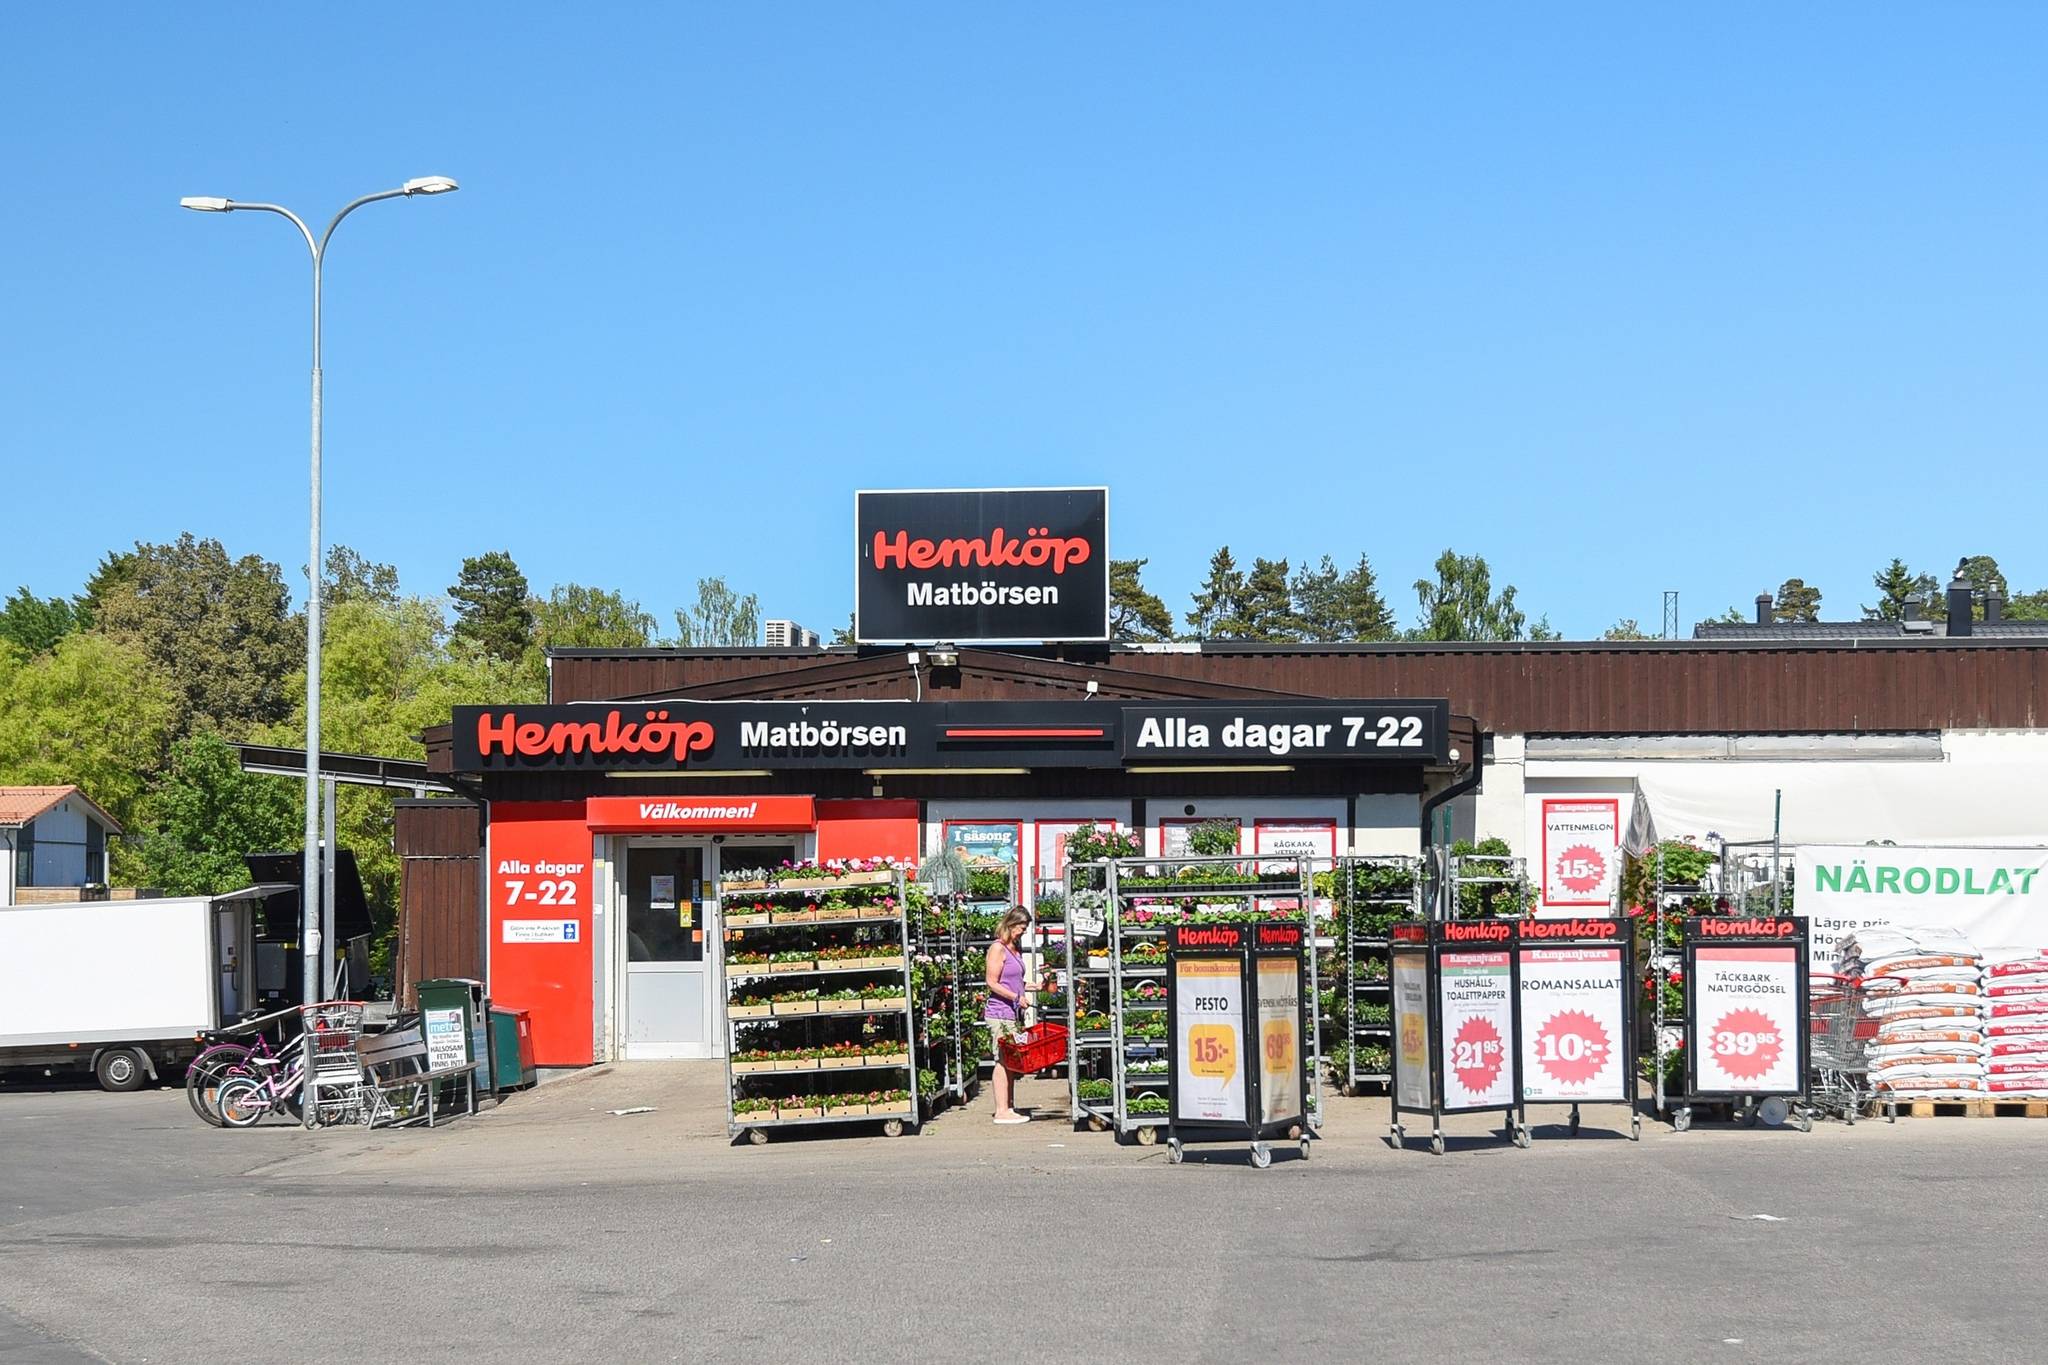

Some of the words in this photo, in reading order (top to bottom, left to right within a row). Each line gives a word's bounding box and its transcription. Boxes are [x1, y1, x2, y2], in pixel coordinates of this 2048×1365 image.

[873, 527, 1090, 575] Hemköp
[907, 581, 1059, 606] Matbörsen
[477, 710, 715, 762] Hemköp
[741, 720, 907, 747] Matbörsen
[1136, 717, 1210, 748] Alla
[1222, 717, 1332, 755] dagar
[1342, 716, 1424, 747] 7-22
[639, 802, 758, 819] Välkommen!
[954, 830, 962, 841] I
[963, 830, 1012, 844] säsong
[1547, 823, 1614, 831] VATTENMELON
[498, 859, 531, 874] Alla
[534, 859, 584, 877] dagar
[1559, 858, 1602, 879] 15:-
[1815, 859, 2040, 895] NÄRODLAT
[505, 879, 577, 906] 7-22
[1445, 921, 1510, 941] Hemköp
[1519, 918, 1617, 938] Hemköp
[1701, 916, 1794, 937] Hemköp
[1814, 916, 1857, 930] Lägre
[1178, 926, 1239, 947] Hemköp
[1260, 925, 1298, 945] Hemköp
[1521, 979, 1621, 991] ROMANSALLAT
[1715, 970, 1771, 982] TÄCKBARK
[1447, 990, 1506, 1001] TOALETTPAPPER
[1707, 983, 1786, 994] NATURGÖDSEL
[1195, 996, 1229, 1011] PESTO
[1194, 1036, 1229, 1063] 15:-
[1540, 1033, 1603, 1061] 10:-
